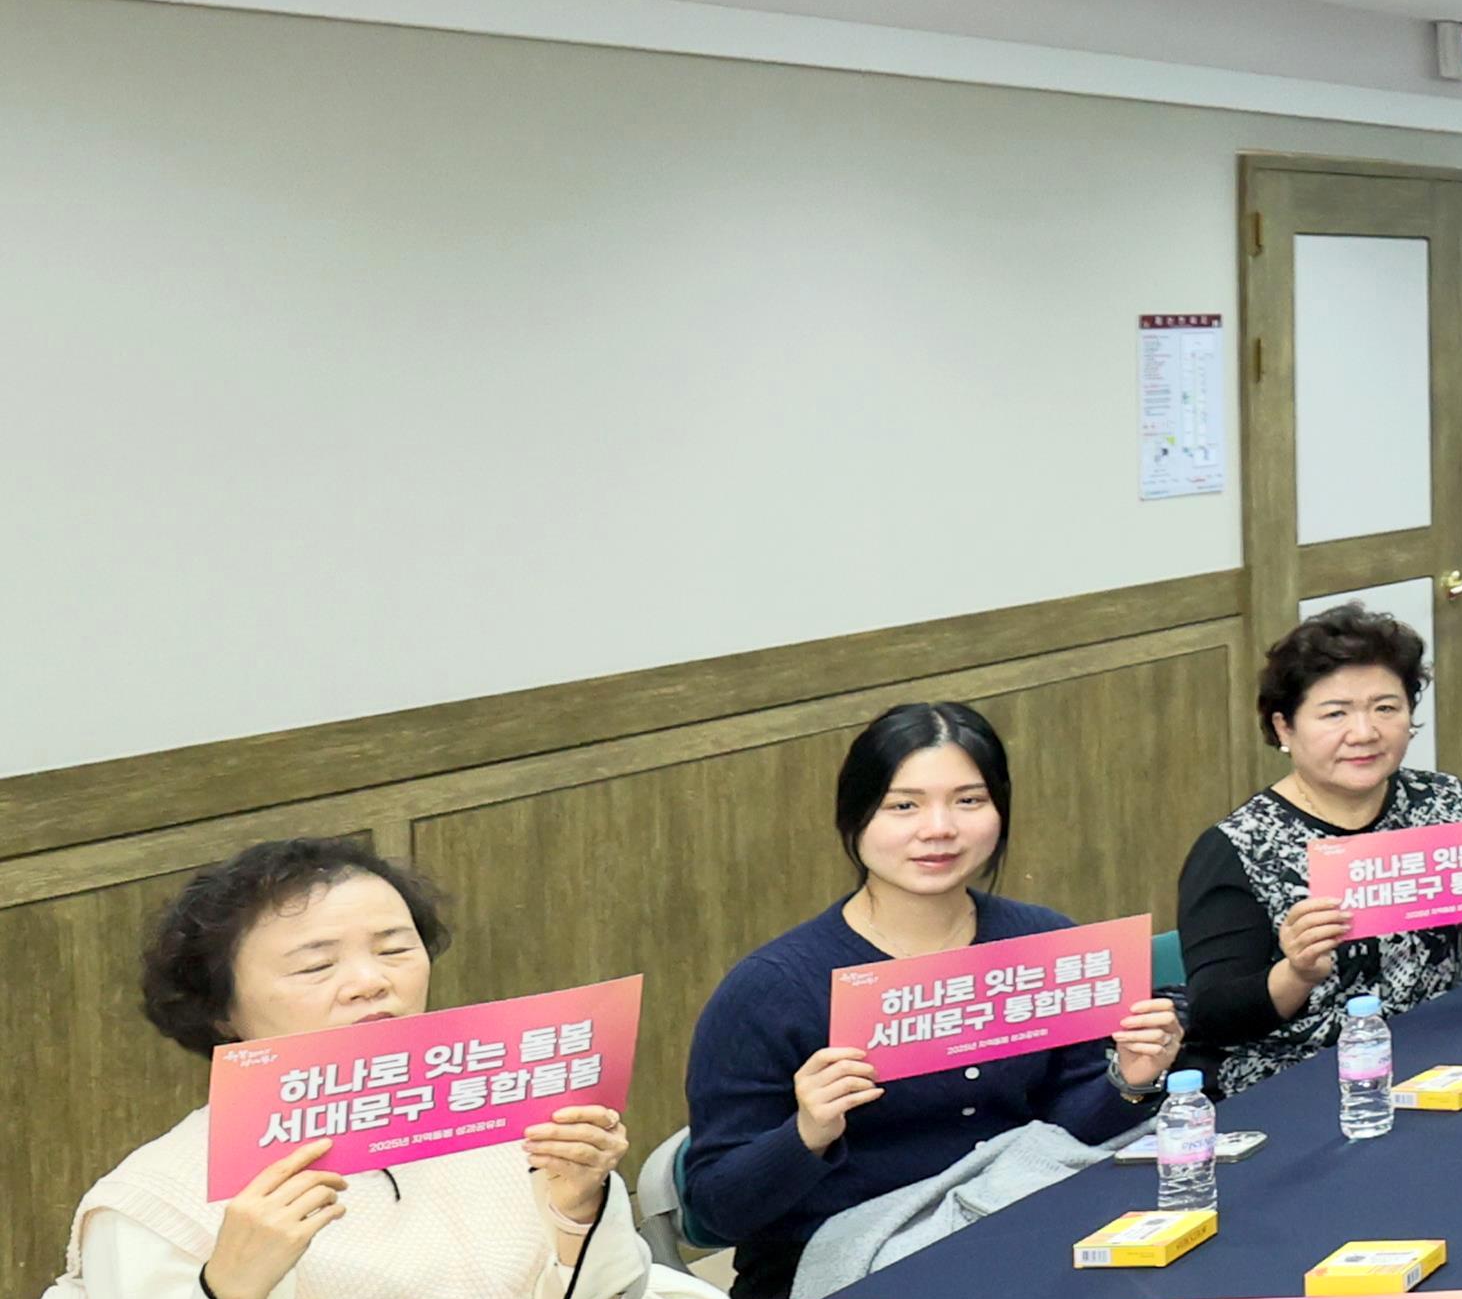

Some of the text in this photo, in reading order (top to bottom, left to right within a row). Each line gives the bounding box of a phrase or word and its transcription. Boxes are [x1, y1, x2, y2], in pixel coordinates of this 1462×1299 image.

[1344, 873, 1443, 911] 서대문구
[1353, 850, 1427, 883] 하나로
[870, 976, 1120, 1050] 서대문구 통합돌봄
[883, 973, 976, 1017] 하나로
[983, 960, 1044, 998] 잇는
[1051, 949, 1110, 985] 돌봄
[279, 1050, 410, 1103] 하나로
[422, 1036, 506, 1080] 잇는
[518, 1020, 594, 1063] 돌봄
[258, 1057, 603, 1149] 서대문구 통합돌봄
